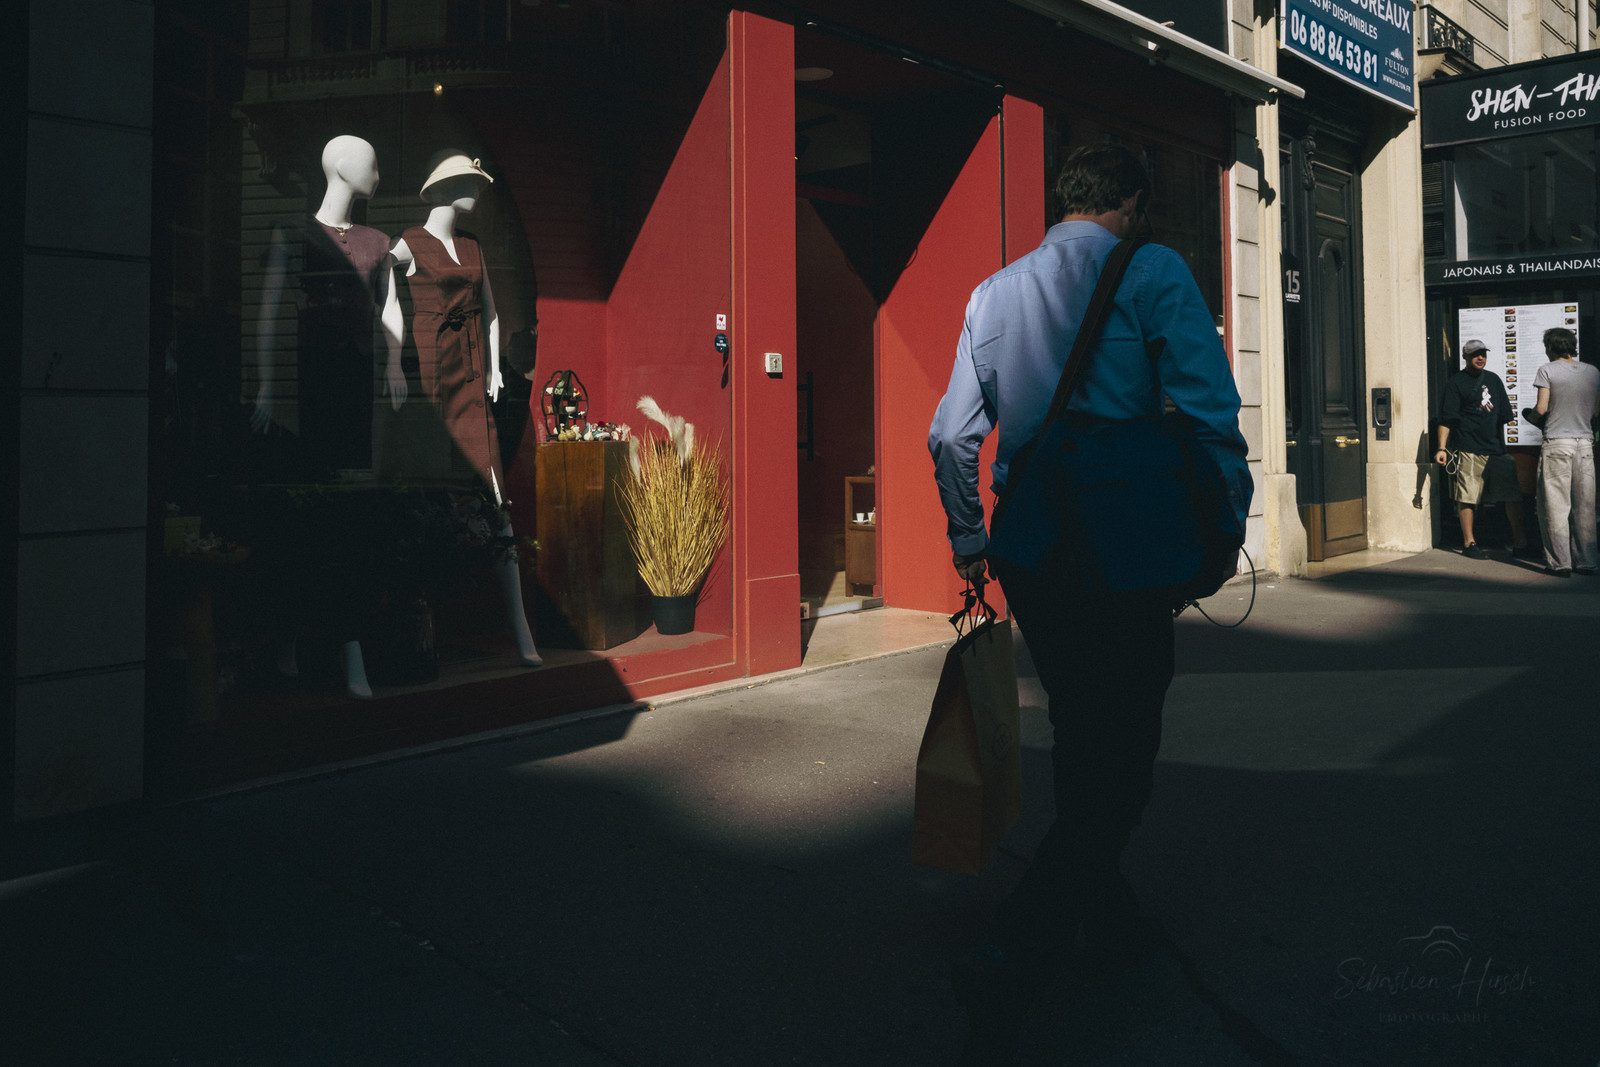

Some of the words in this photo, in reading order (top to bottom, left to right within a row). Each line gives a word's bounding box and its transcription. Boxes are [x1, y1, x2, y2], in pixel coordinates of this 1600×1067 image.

[1332, 3, 1378, 40] DISPONIBLES
[1351, 0, 1410, 34] REAUX
[1291, 9, 1307, 46] 06
[1310, 20, 1326, 56] 88
[1328, 30, 1344, 66] 84
[1346, 39, 1361, 74] 53
[1363, 50, 1377, 83] 81
[1384, 56, 1409, 76] FULTON
[1494, 114, 1542, 129] FUSION
[1548, 108, 1587, 121] FOOD
[1285, 269, 1300, 294] 15
[1443, 264, 1502, 279] JAPONAIS
[1506, 264, 1516, 275] &
